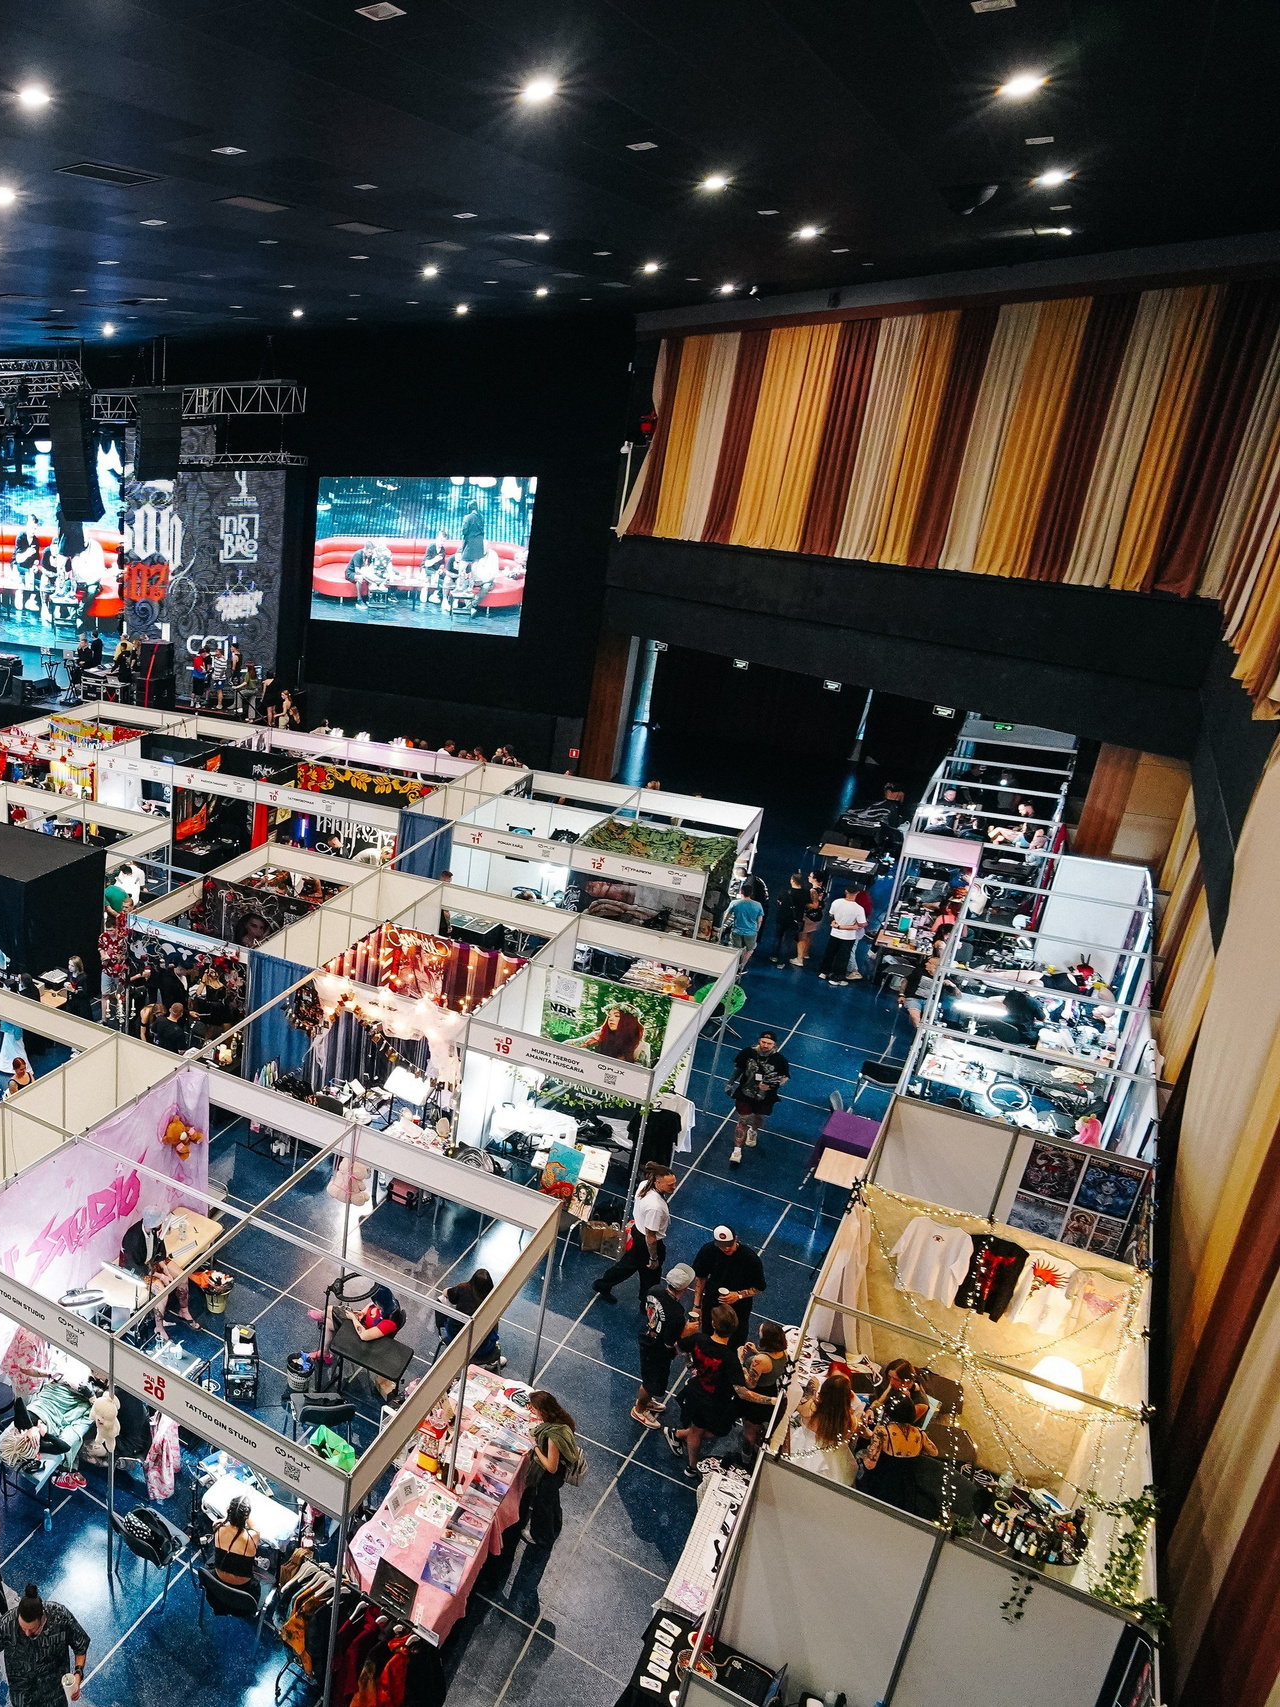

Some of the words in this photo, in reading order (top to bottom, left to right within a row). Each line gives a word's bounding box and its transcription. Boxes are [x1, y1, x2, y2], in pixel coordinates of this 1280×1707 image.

[592, 862, 602, 870] 12
[549, 1001, 577, 1018] NBK
[495, 1043, 510, 1054] 19
[531, 1047, 552, 1059] MURAT
[552, 1053, 580, 1066] TSERGOY
[525, 1052, 552, 1064] AMANITA
[552, 1060, 584, 1074] MUSCARIA
[12, 1297, 23, 1308] GIN
[23, 1303, 46, 1321] STUDIO
[144, 1380, 165, 1401] 20
[184, 1400, 213, 1422] TATTOO
[213, 1418, 227, 1431] GIN
[227, 1427, 258, 1449] STUDIO
